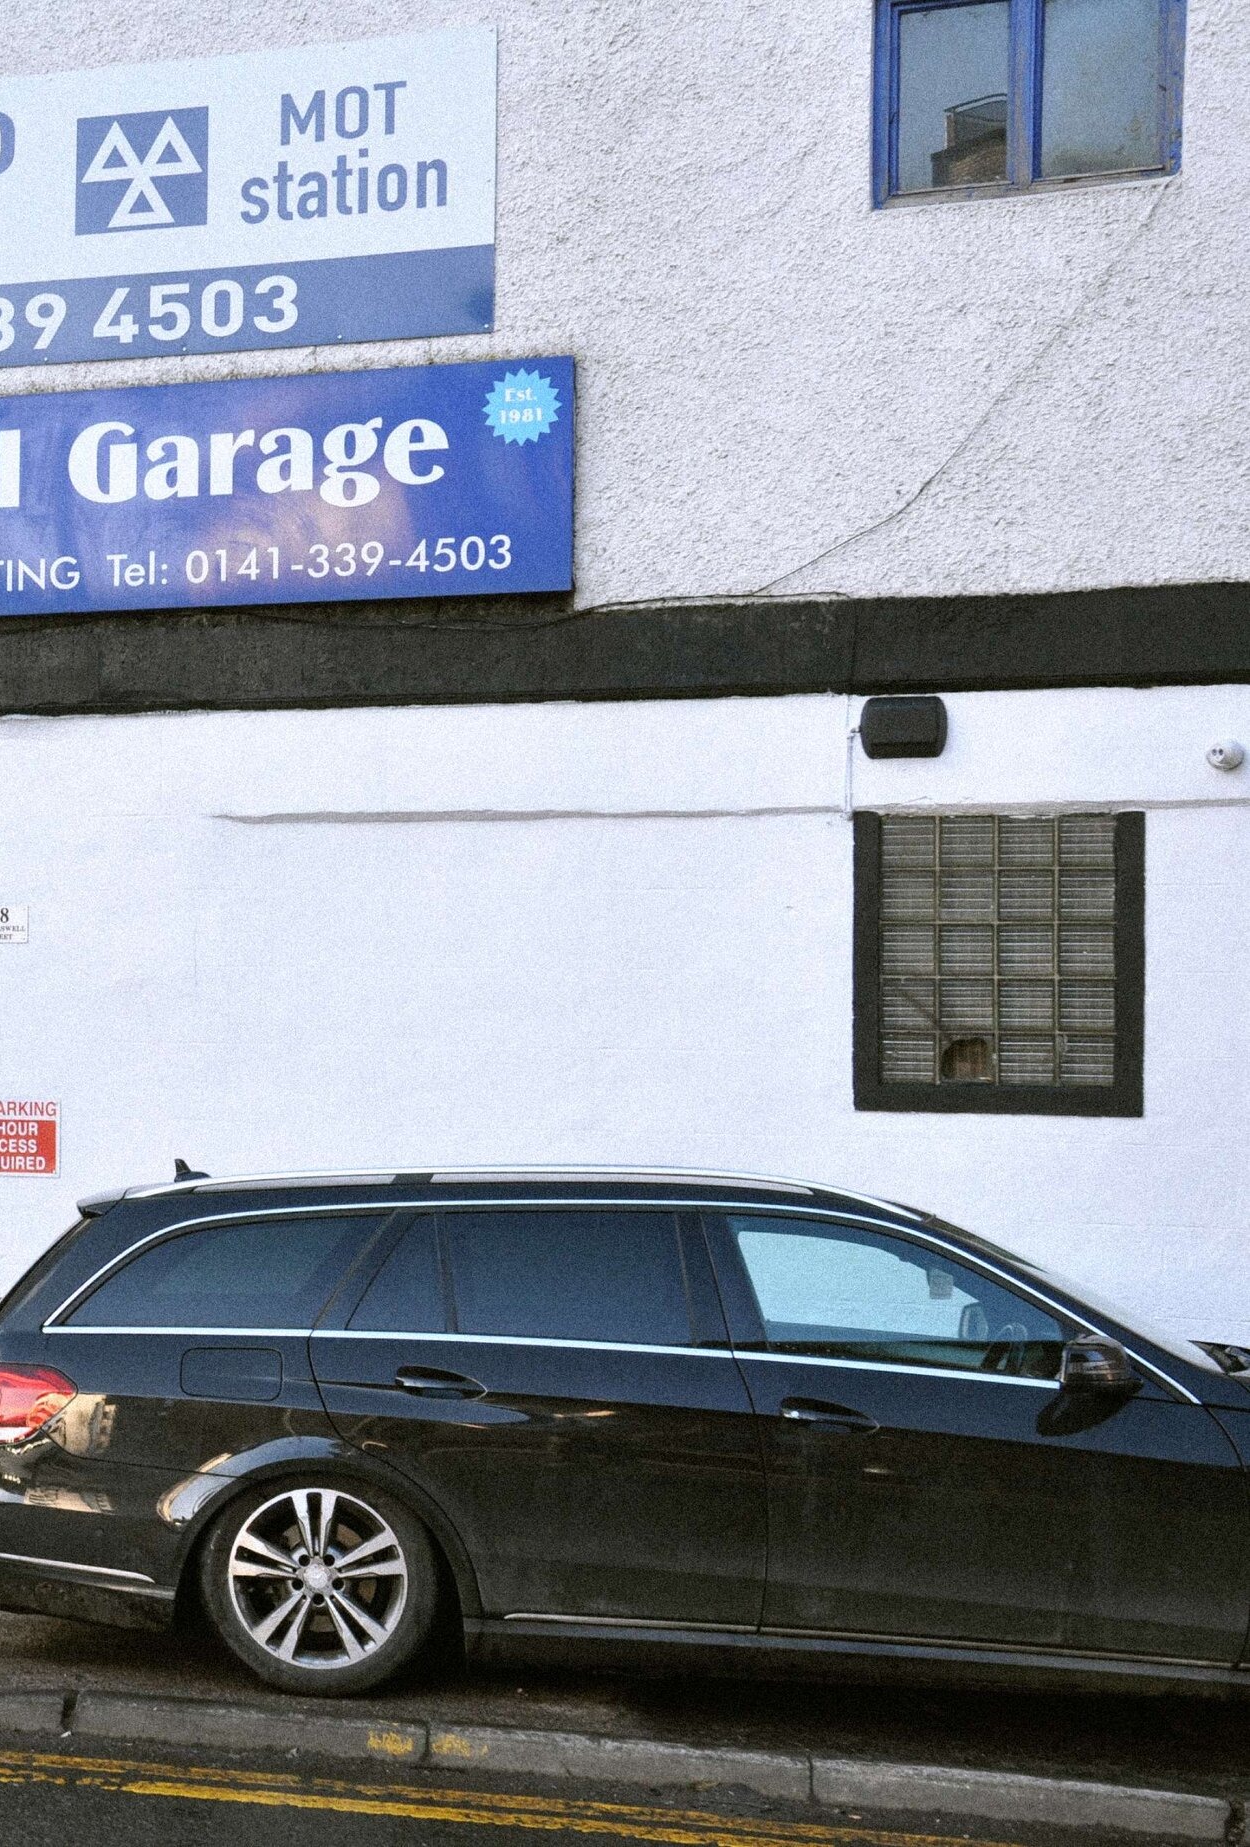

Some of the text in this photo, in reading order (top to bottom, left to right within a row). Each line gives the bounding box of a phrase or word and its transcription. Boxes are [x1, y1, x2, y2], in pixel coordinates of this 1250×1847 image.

[280, 81, 407, 145] MOT
[240, 149, 447, 224] station
[93, 276, 298, 343] 4503
[499, 407, 542, 424] 1981
[505, 387, 537, 402] Est.
[68, 416, 449, 508] Garage
[107, 552, 169, 587] Tel:
[185, 534, 512, 582] 0141-339-4503
